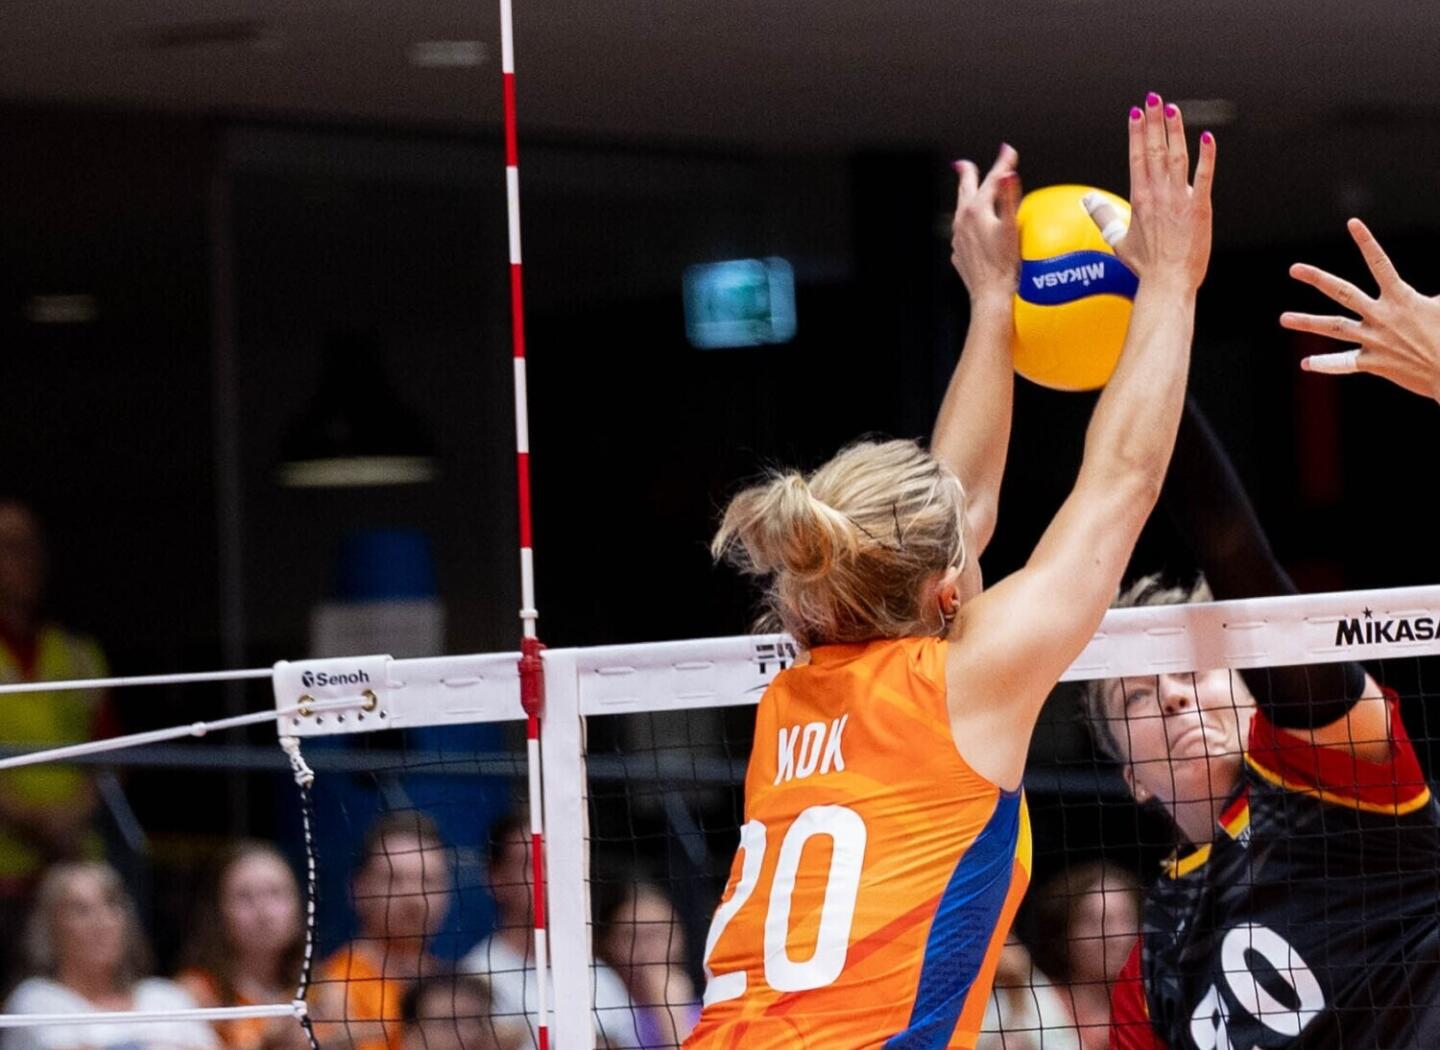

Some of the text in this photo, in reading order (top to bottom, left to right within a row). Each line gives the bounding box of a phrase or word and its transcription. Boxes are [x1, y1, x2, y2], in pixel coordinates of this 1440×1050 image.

[316, 669, 370, 686] Senoh
[773, 713, 848, 786] KOK
[702, 804, 868, 1009] 20
